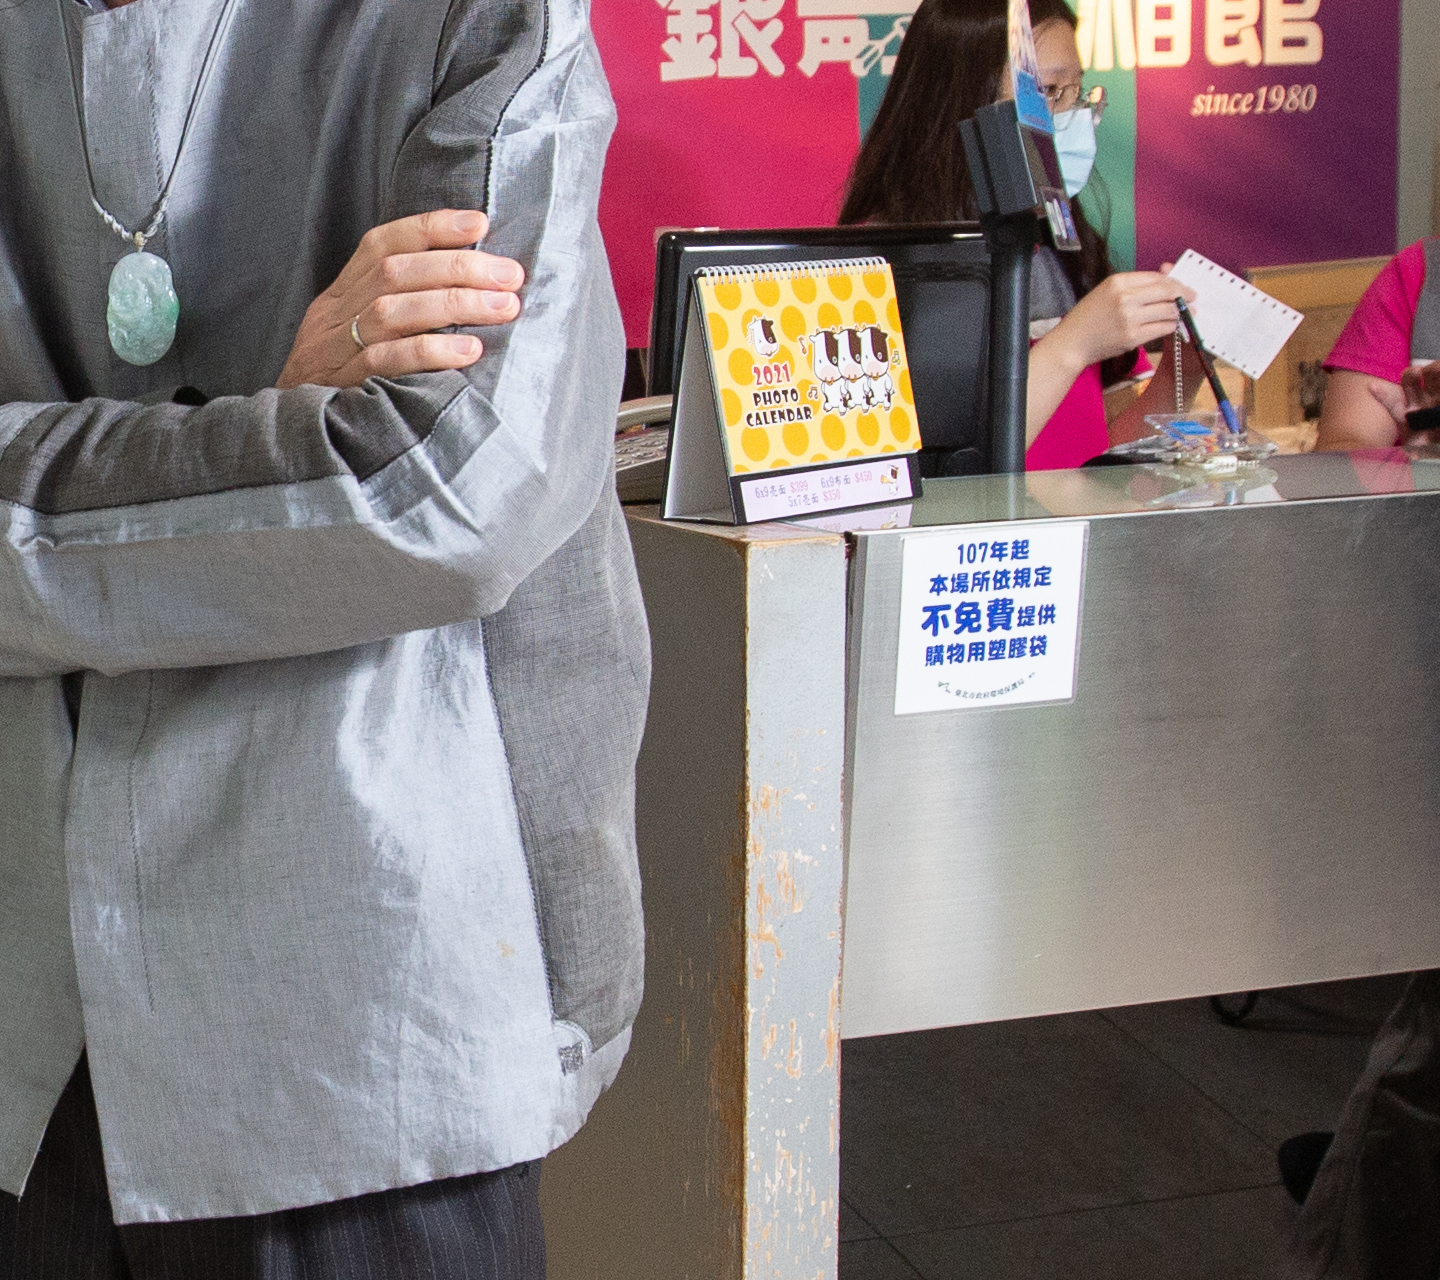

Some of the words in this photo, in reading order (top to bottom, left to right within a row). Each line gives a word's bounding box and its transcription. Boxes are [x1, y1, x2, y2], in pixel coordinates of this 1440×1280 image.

[753, 363, 791, 386] 2021
[753, 388, 799, 406] PHOTO
[746, 406, 813, 427] CALENDAR
[790, 480, 809, 493] $399
[957, 539, 1030, 565] 107年起
[929, 565, 1053, 596] 本場所依規定
[921, 597, 1056, 637] 不免費提供
[924, 634, 1048, 667] 購物用塑膠袋
